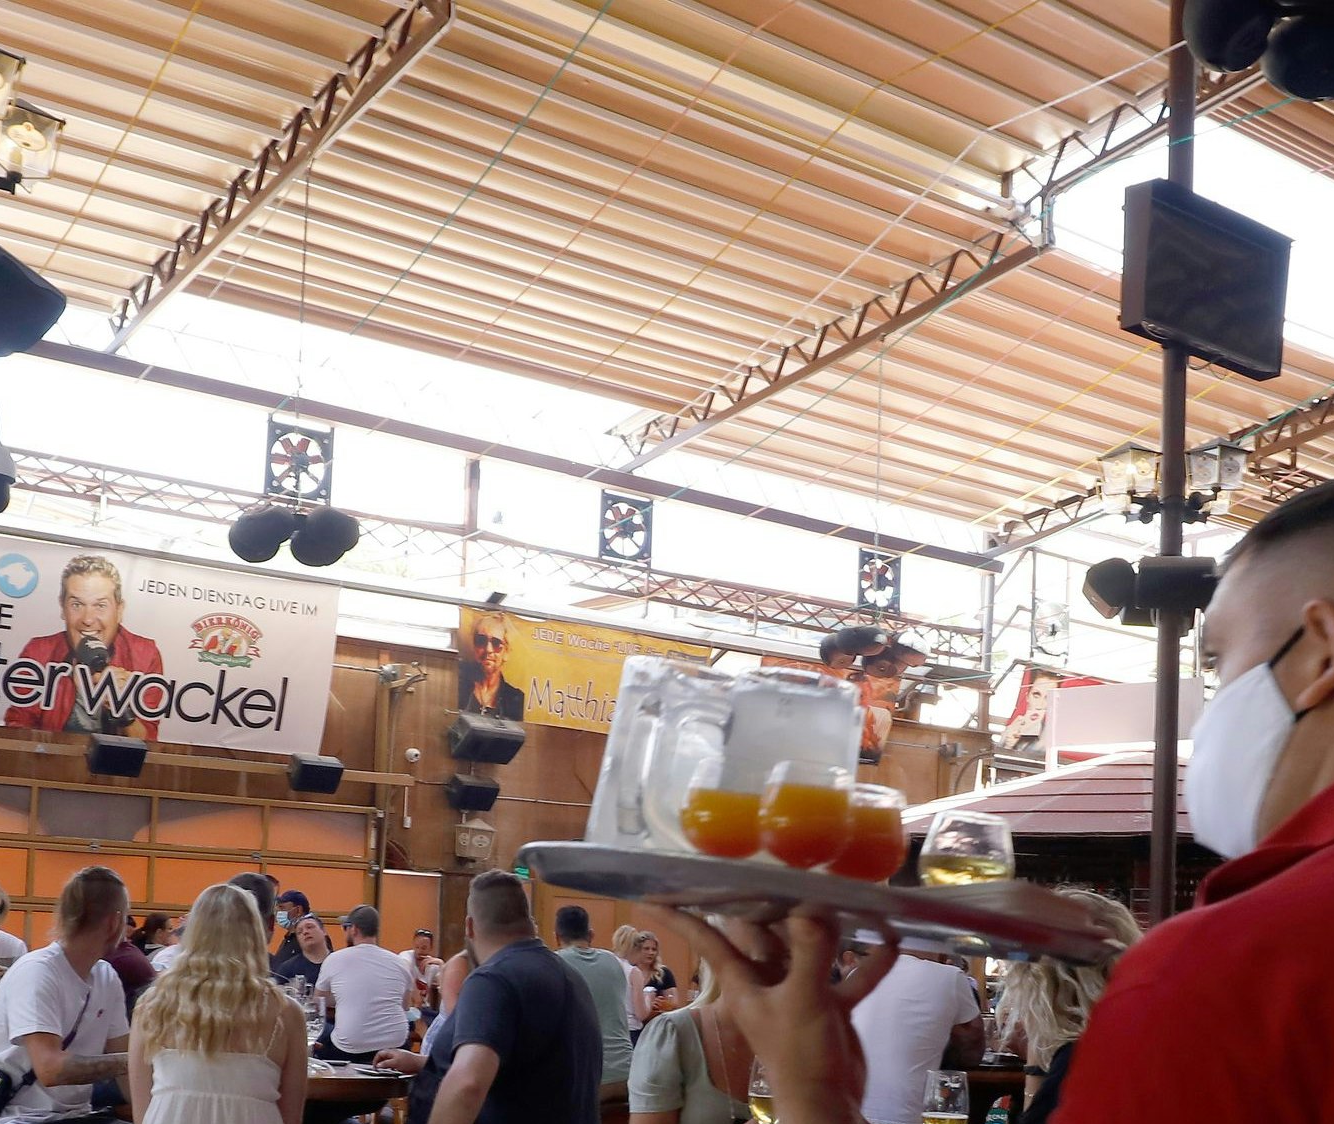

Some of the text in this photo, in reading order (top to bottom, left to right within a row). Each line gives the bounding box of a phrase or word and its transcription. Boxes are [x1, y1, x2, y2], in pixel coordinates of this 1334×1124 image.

[138, 579, 318, 616] JEDEN DIENSTAG LIVE IM
[531, 627, 565, 645] JEDE
[567, 633, 611, 653] Woche
[79, 664, 289, 732] wackel
